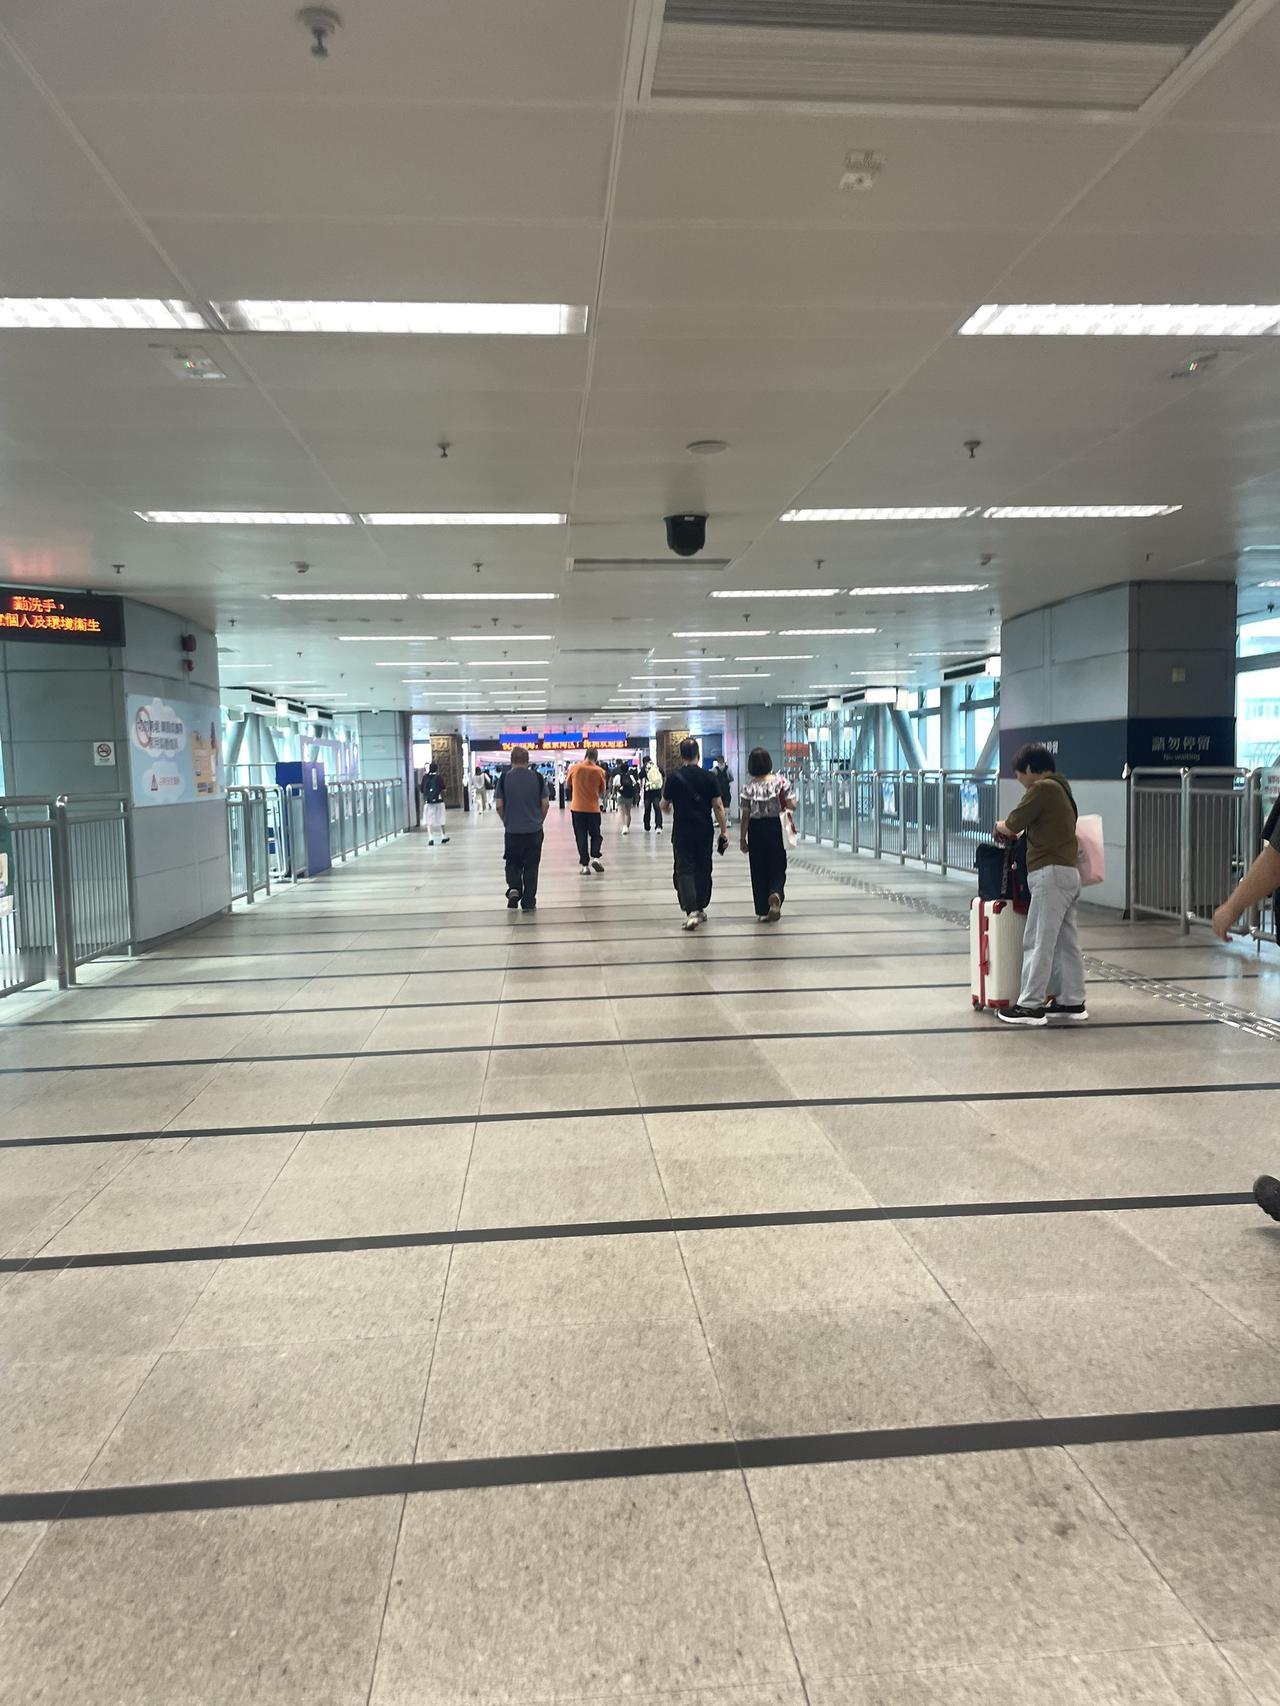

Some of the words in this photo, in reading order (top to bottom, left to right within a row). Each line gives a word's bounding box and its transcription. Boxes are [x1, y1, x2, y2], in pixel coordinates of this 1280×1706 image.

[1151, 735, 1211, 752] 請勿停留
[1163, 753, 1174, 761] No
[1175, 753, 1201, 762] waiting
